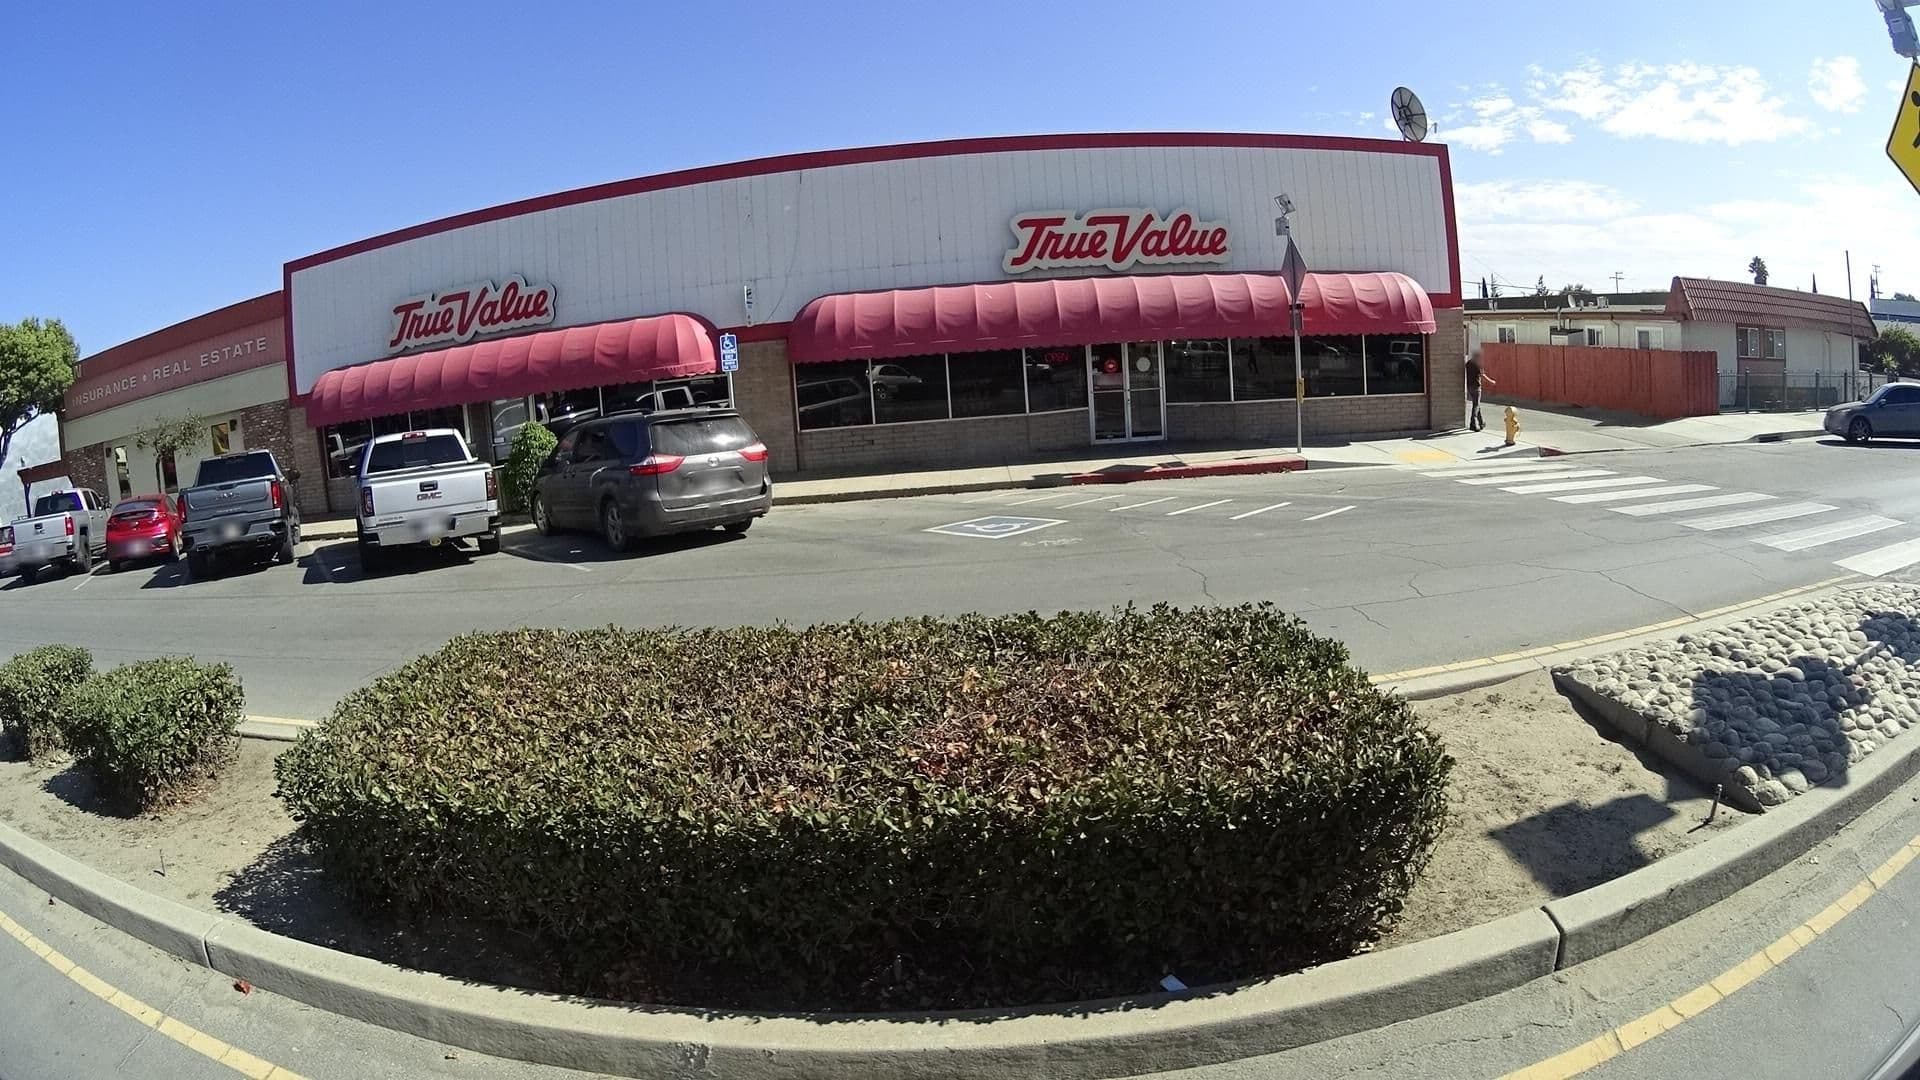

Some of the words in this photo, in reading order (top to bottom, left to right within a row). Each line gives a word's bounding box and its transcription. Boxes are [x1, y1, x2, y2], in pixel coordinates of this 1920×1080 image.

[1010, 217, 1107, 266] True
[1086, 213, 1227, 263] Value
[391, 301, 454, 347] True
[439, 281, 548, 336] Value
[73, 376, 137, 406] INSURANCE
[152, 359, 192, 381] REAL
[200, 336, 267, 367] ESTATE
[417, 491, 442, 501] GMC
